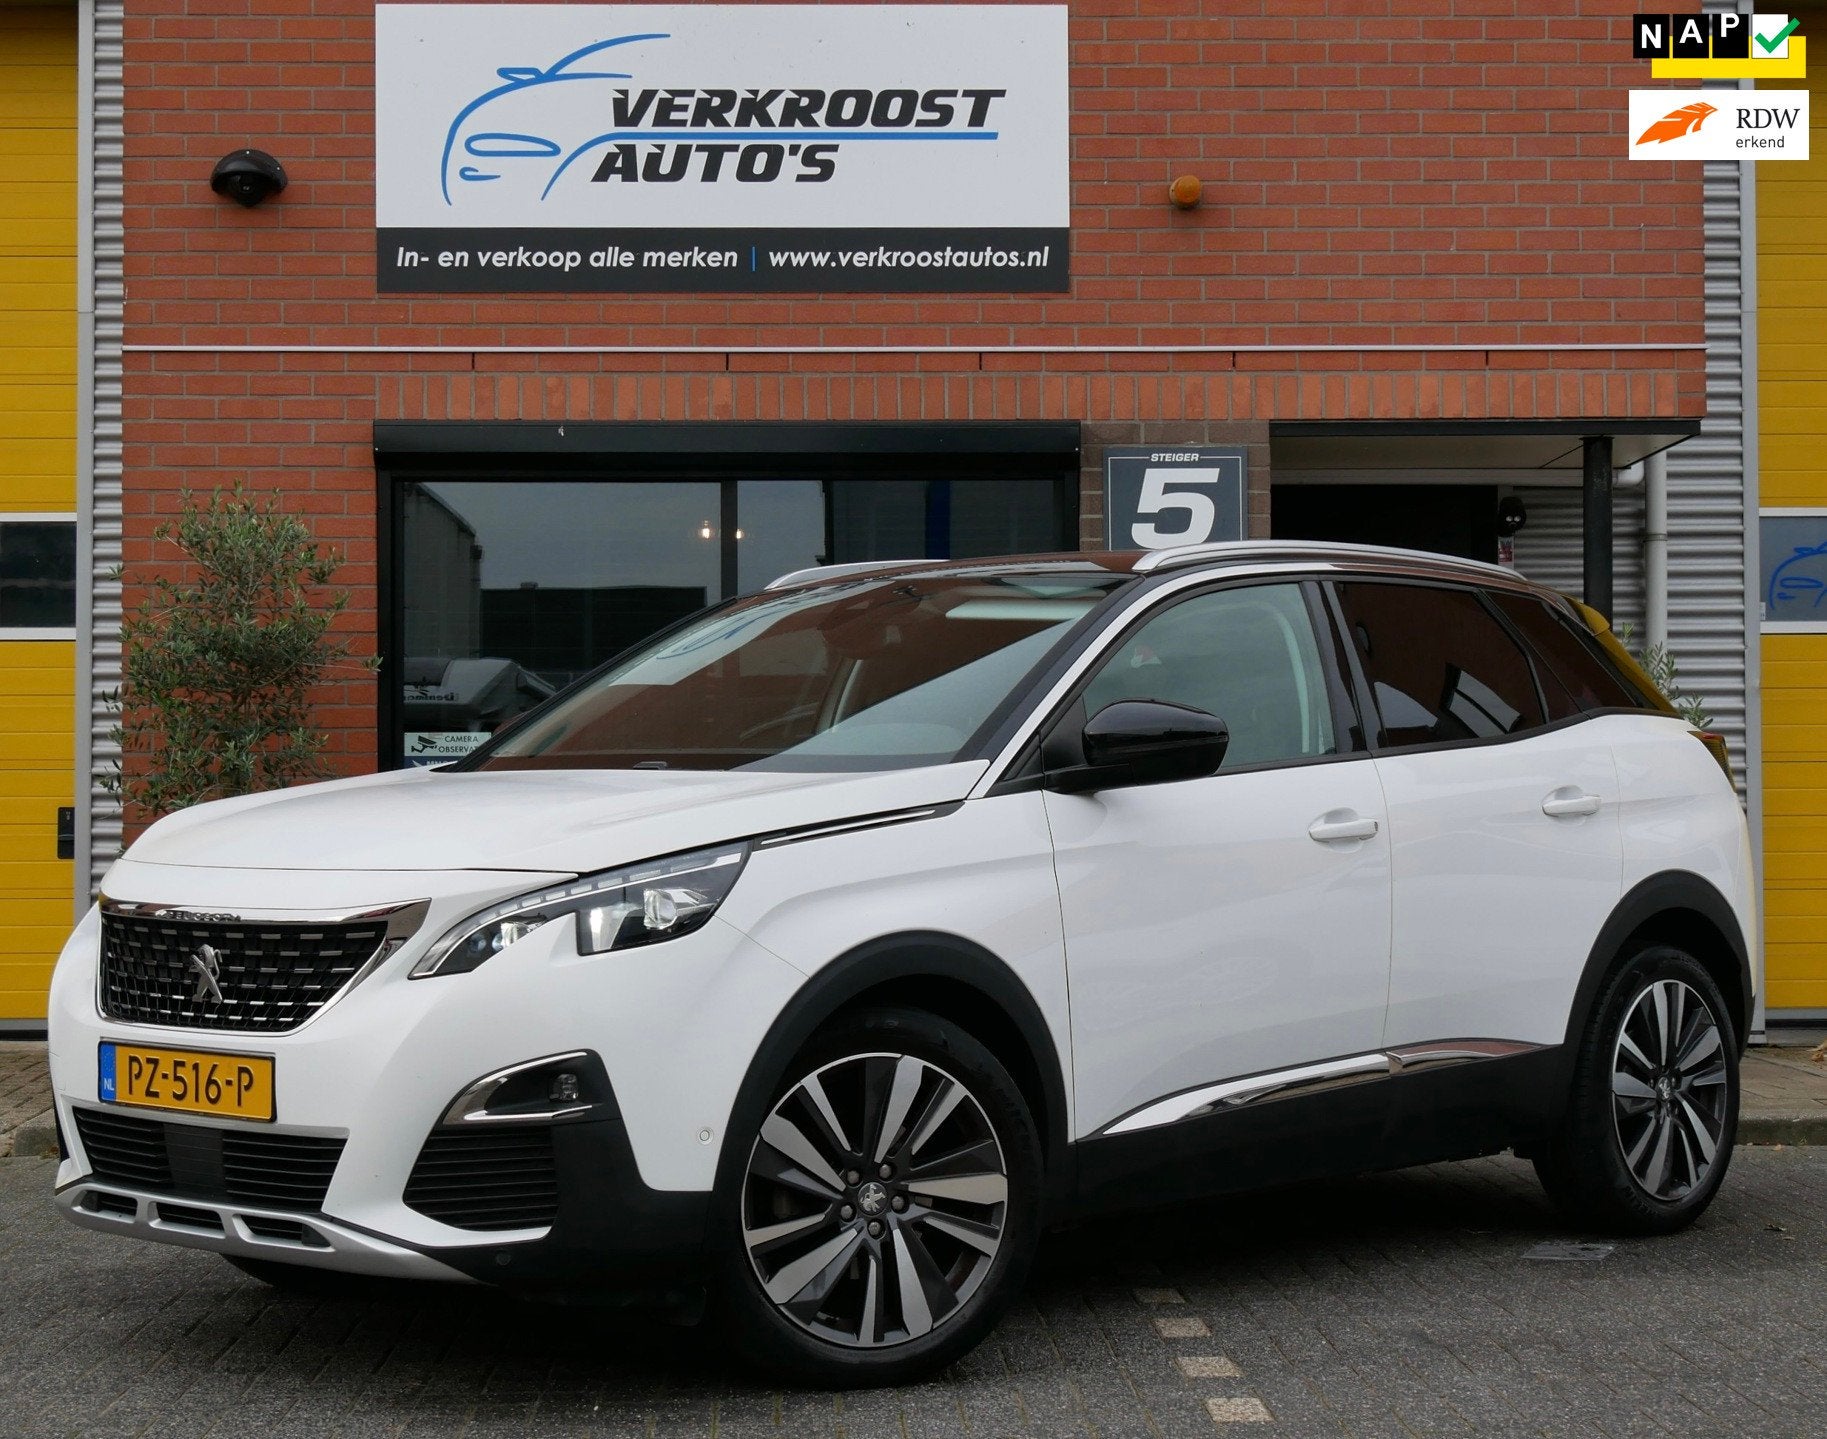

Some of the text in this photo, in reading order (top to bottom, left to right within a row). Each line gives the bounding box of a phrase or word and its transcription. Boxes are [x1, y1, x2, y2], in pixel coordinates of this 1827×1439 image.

[611, 88, 1007, 129] VERKROOST
[591, 143, 840, 183] AUTO'S
[397, 246, 739, 272] In- en verkoop alle merken
[768, 246, 1050, 268] www.verkroostautos.nl
[1150, 453, 1200, 462] STEIGER
[1131, 467, 1220, 550] 5
[444, 735, 479, 743] CAMERA
[103, 1078, 114, 1091] NL
[127, 1054, 254, 1107] PZ-516-P
